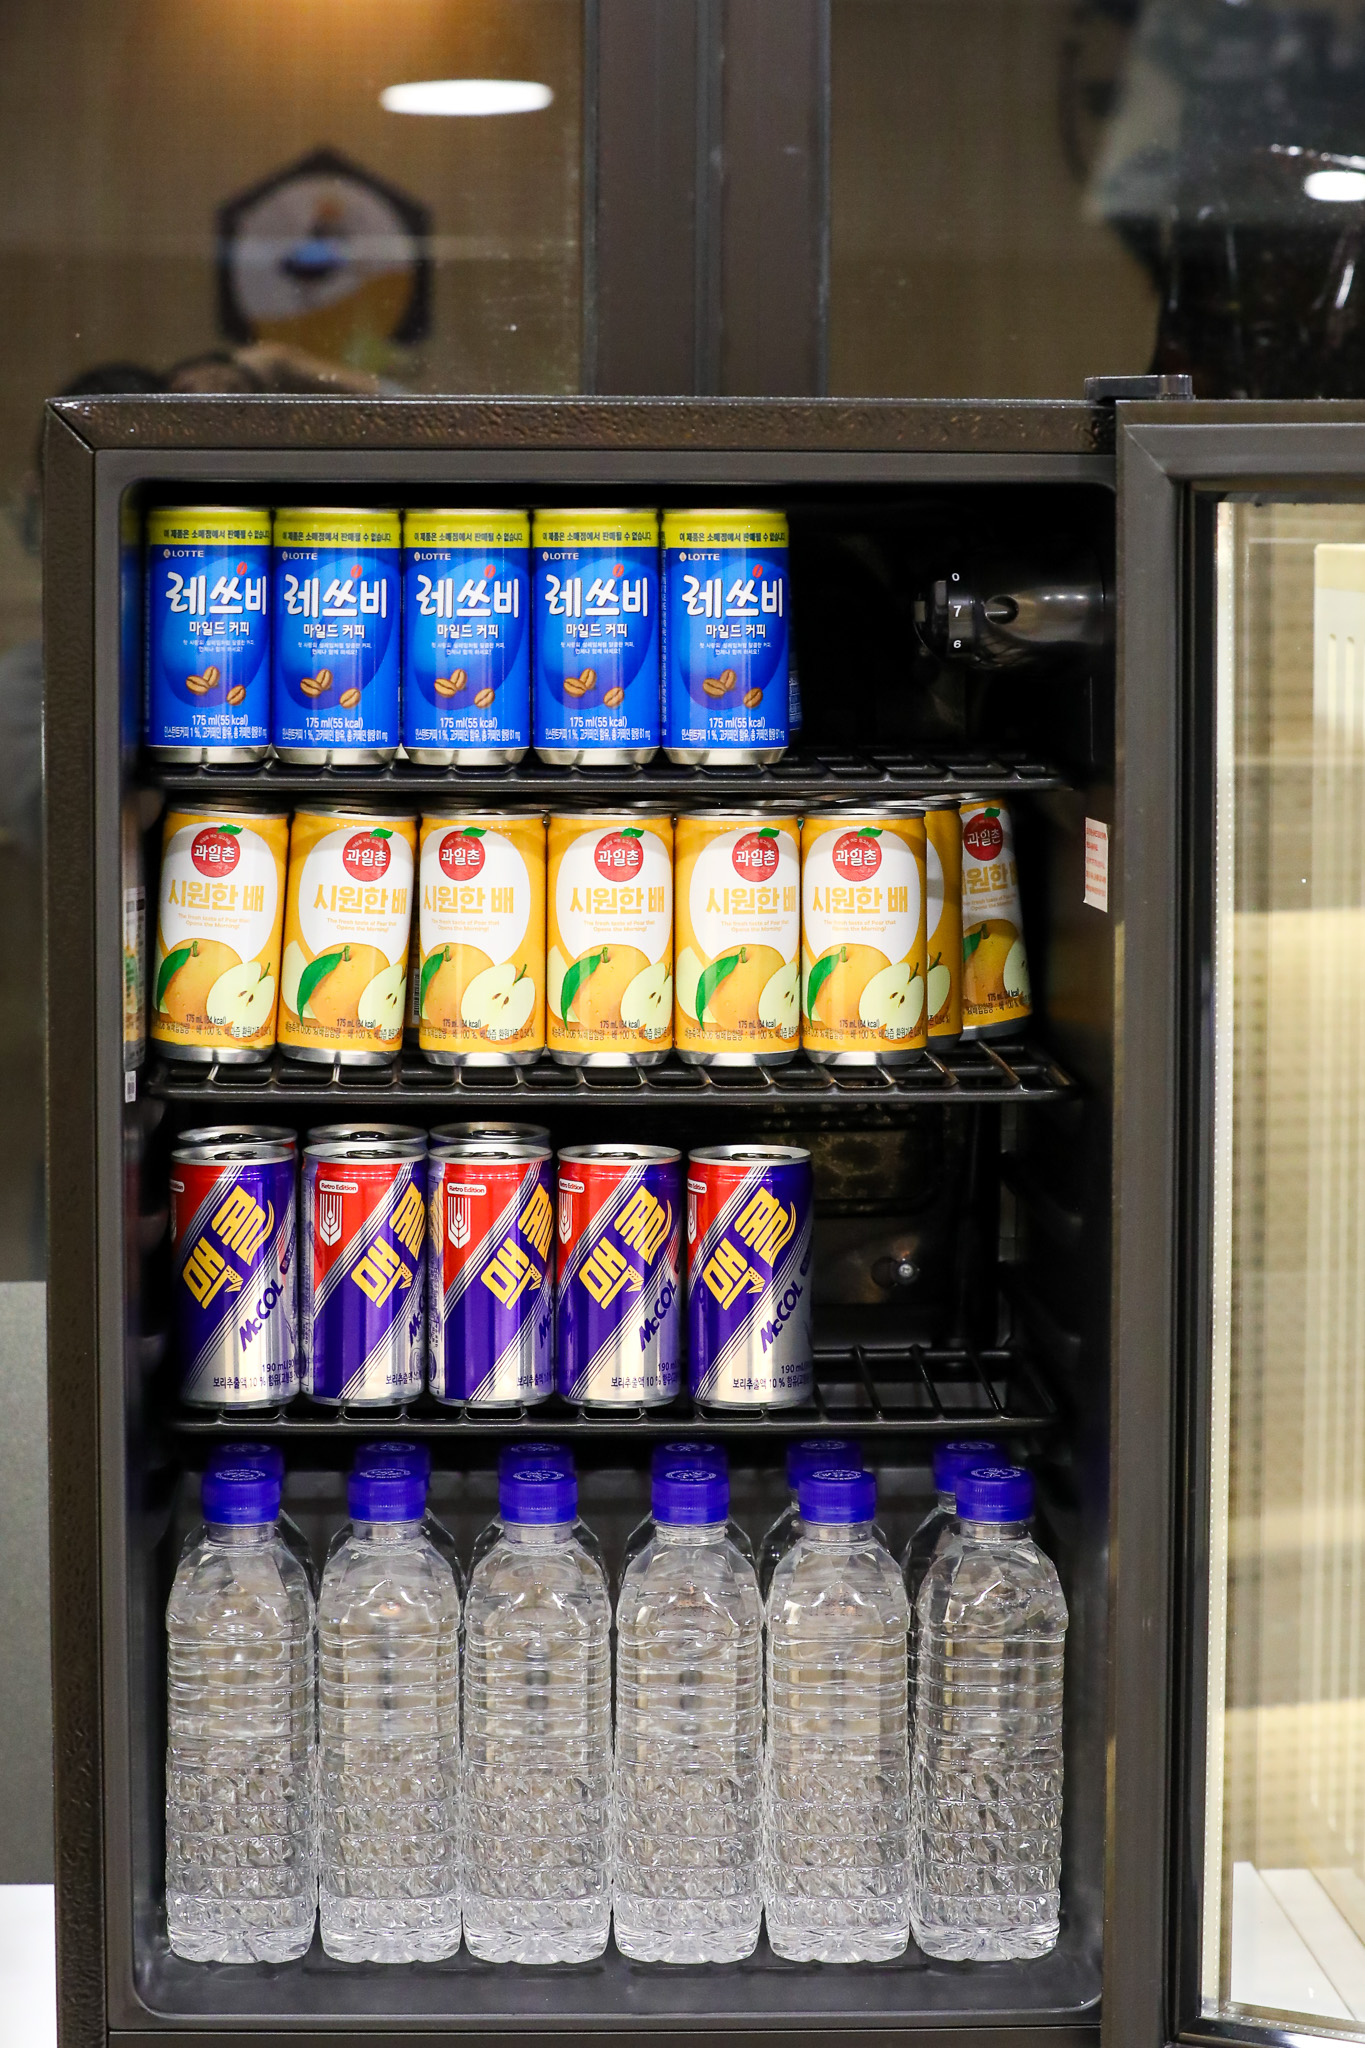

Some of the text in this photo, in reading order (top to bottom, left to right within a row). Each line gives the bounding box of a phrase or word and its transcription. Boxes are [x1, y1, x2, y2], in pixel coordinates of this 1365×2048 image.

[171, 530, 189, 539] 제품은
[192, 530, 225, 539] 소매점에서
[288, 532, 303, 541] 제품은
[306, 532, 338, 541] 소매점에서
[420, 532, 437, 541] 제품은
[439, 532, 472, 541] 소매점에서
[548, 532, 564, 541] 제품은
[567, 532, 600, 541] 소매점에서
[687, 532, 705, 542] 제품은
[707, 532, 741, 542] 소매점에서
[166, 572, 266, 616] 레쓰비
[284, 574, 387, 618] 레쓰비
[416, 574, 519, 618] 레쓰비
[545, 574, 648, 618] 레쓰비
[682, 574, 783, 618] 레쓰비
[953, 605, 962, 618] 7
[189, 622, 250, 636] 마일드 커피
[304, 624, 365, 639] 마일드 커피
[437, 624, 499, 639] 마일드 커피
[566, 624, 628, 638] 마일드 커피
[706, 624, 766, 639] 마일드 커피
[953, 640, 962, 648] 6
[192, 715, 248, 726] 175 ml(55 kcal)
[306, 717, 363, 729] 175 ml(55 kcal)
[440, 717, 498, 729] 175 ml(55 kcal)
[570, 716, 627, 728] 175 ml(55 kcal)
[709, 717, 765, 728] 175 ml(55 kcal)
[967, 829, 1000, 847] 과일촌
[194, 844, 235, 863] 과일촌
[346, 848, 386, 867] 과일촌
[441, 848, 480, 866] 과일촌
[598, 848, 639, 867] 과일촌
[736, 848, 776, 867] 과일촌
[836, 848, 877, 866] 과일촌
[168, 879, 264, 912] 시원한 배
[313, 884, 407, 914] 시원한 배
[424, 884, 514, 914] 시원한 배
[570, 886, 664, 914] 시원한 배
[706, 886, 779, 914] 시원한
[812, 886, 908, 914] 시원한 배
[186, 1014, 195, 1022] 175
[213, 1016, 226, 1025] kcal)
[337, 1019, 346, 1027] 175
[364, 1020, 376, 1028] kcal)
[443, 1019, 451, 1027] 175
[469, 1019, 481, 1028] kcal)
[600, 1020, 609, 1028] 175
[628, 1019, 640, 1029] kcal)
[738, 1020, 747, 1028] 175
[766, 1019, 776, 1028] kcal)
[840, 1020, 848, 1028] 175
[867, 1019, 880, 1029] kcal)
[321, 1182, 335, 1190] Retro
[183, 1184, 275, 1309] 맥콜
[351, 1181, 426, 1308] 맥콜
[480, 1183, 554, 1310] 맥콜
[579, 1185, 672, 1310] 맥콜
[702, 1186, 796, 1311] 맥콜
[239, 1279, 284, 1352] McCOL
[639, 1279, 677, 1352] McCOL
[760, 1280, 803, 1354] McCOL
[262, 1363, 276, 1372] 190
[658, 1363, 669, 1372] 190
[782, 1364, 794, 1373] 190
[213, 1377, 247, 1389] 보리추출액
[249, 1378, 257, 1386] 10
[611, 1377, 644, 1388] 보리추출액
[647, 1376, 653, 1386] 10
[733, 1378, 785, 1390] 보리추출액 10 %
